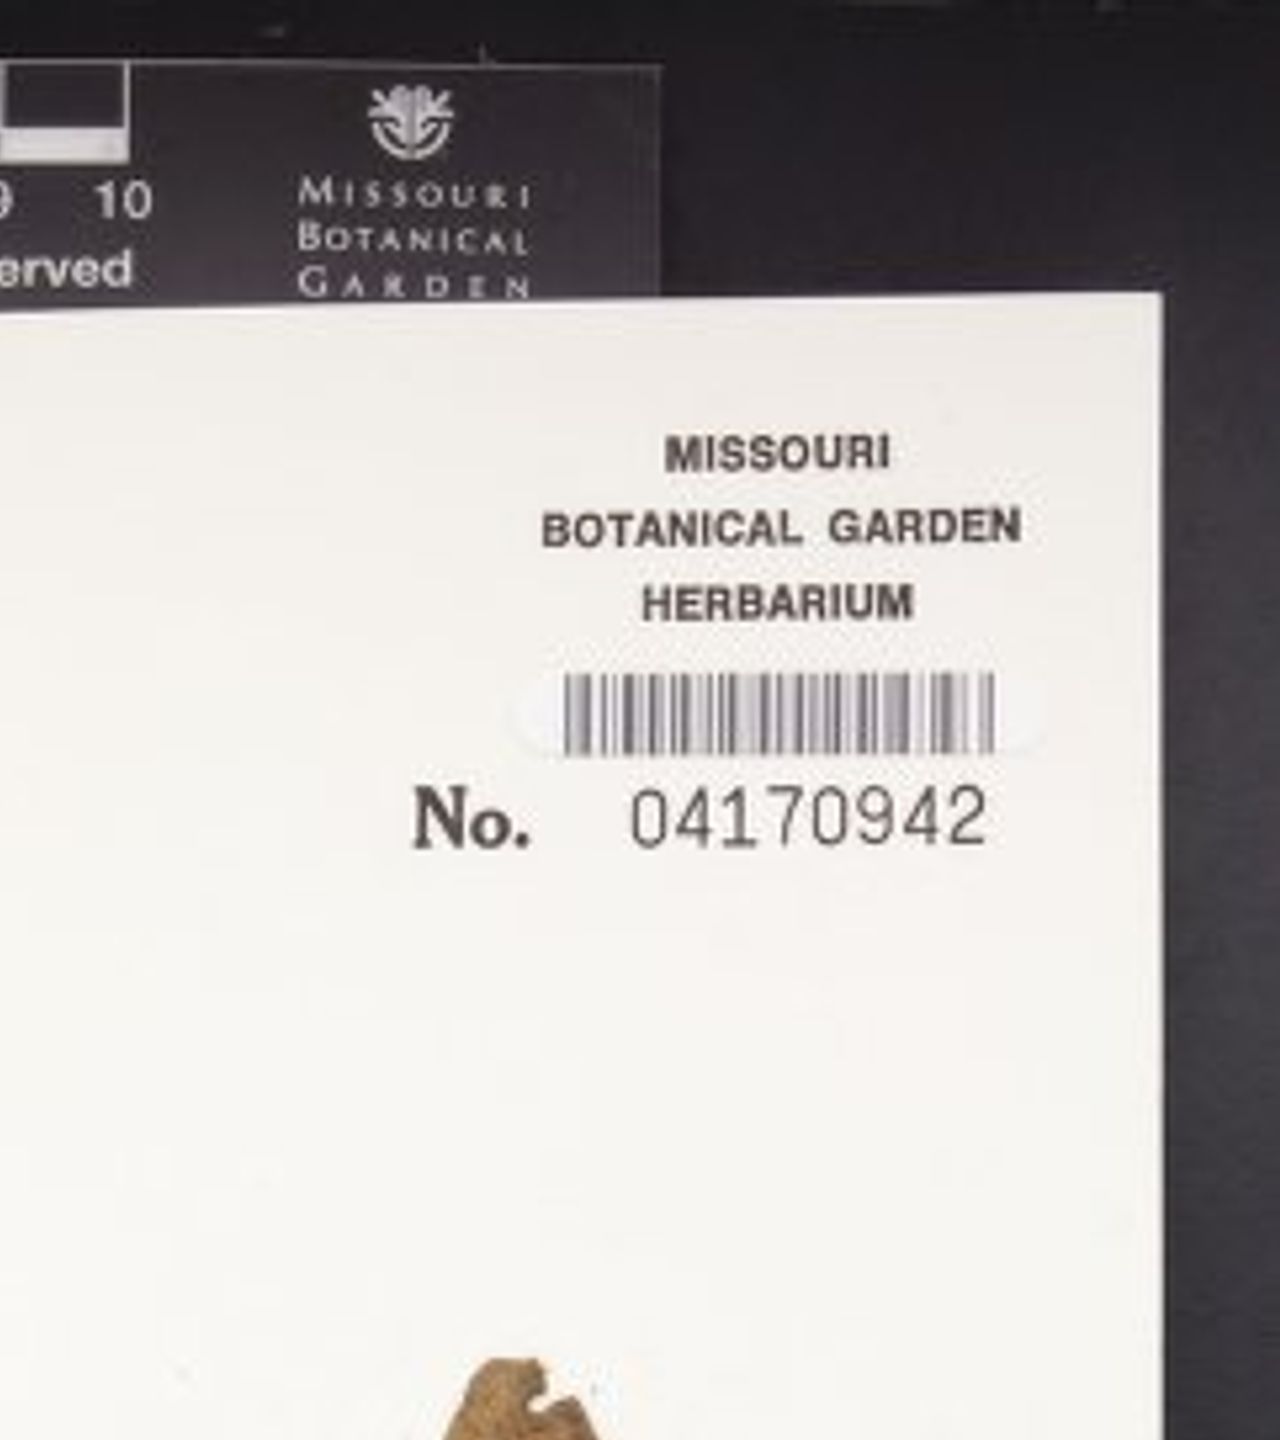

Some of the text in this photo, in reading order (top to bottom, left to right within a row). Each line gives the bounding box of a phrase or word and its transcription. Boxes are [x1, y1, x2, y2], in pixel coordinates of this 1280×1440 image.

[97, 179, 152, 219] 10
[297, 174, 530, 209] MISSOURI
[297, 218, 529, 256] BOTANICAL
[297, 264, 529, 299] GARDEN
[663, 433, 891, 473] MISSOURI
[541, 507, 1022, 548] BOTANICAL GARDEN
[640, 583, 915, 622] HERBARIUM
[412, 785, 986, 850] No. 04170942
